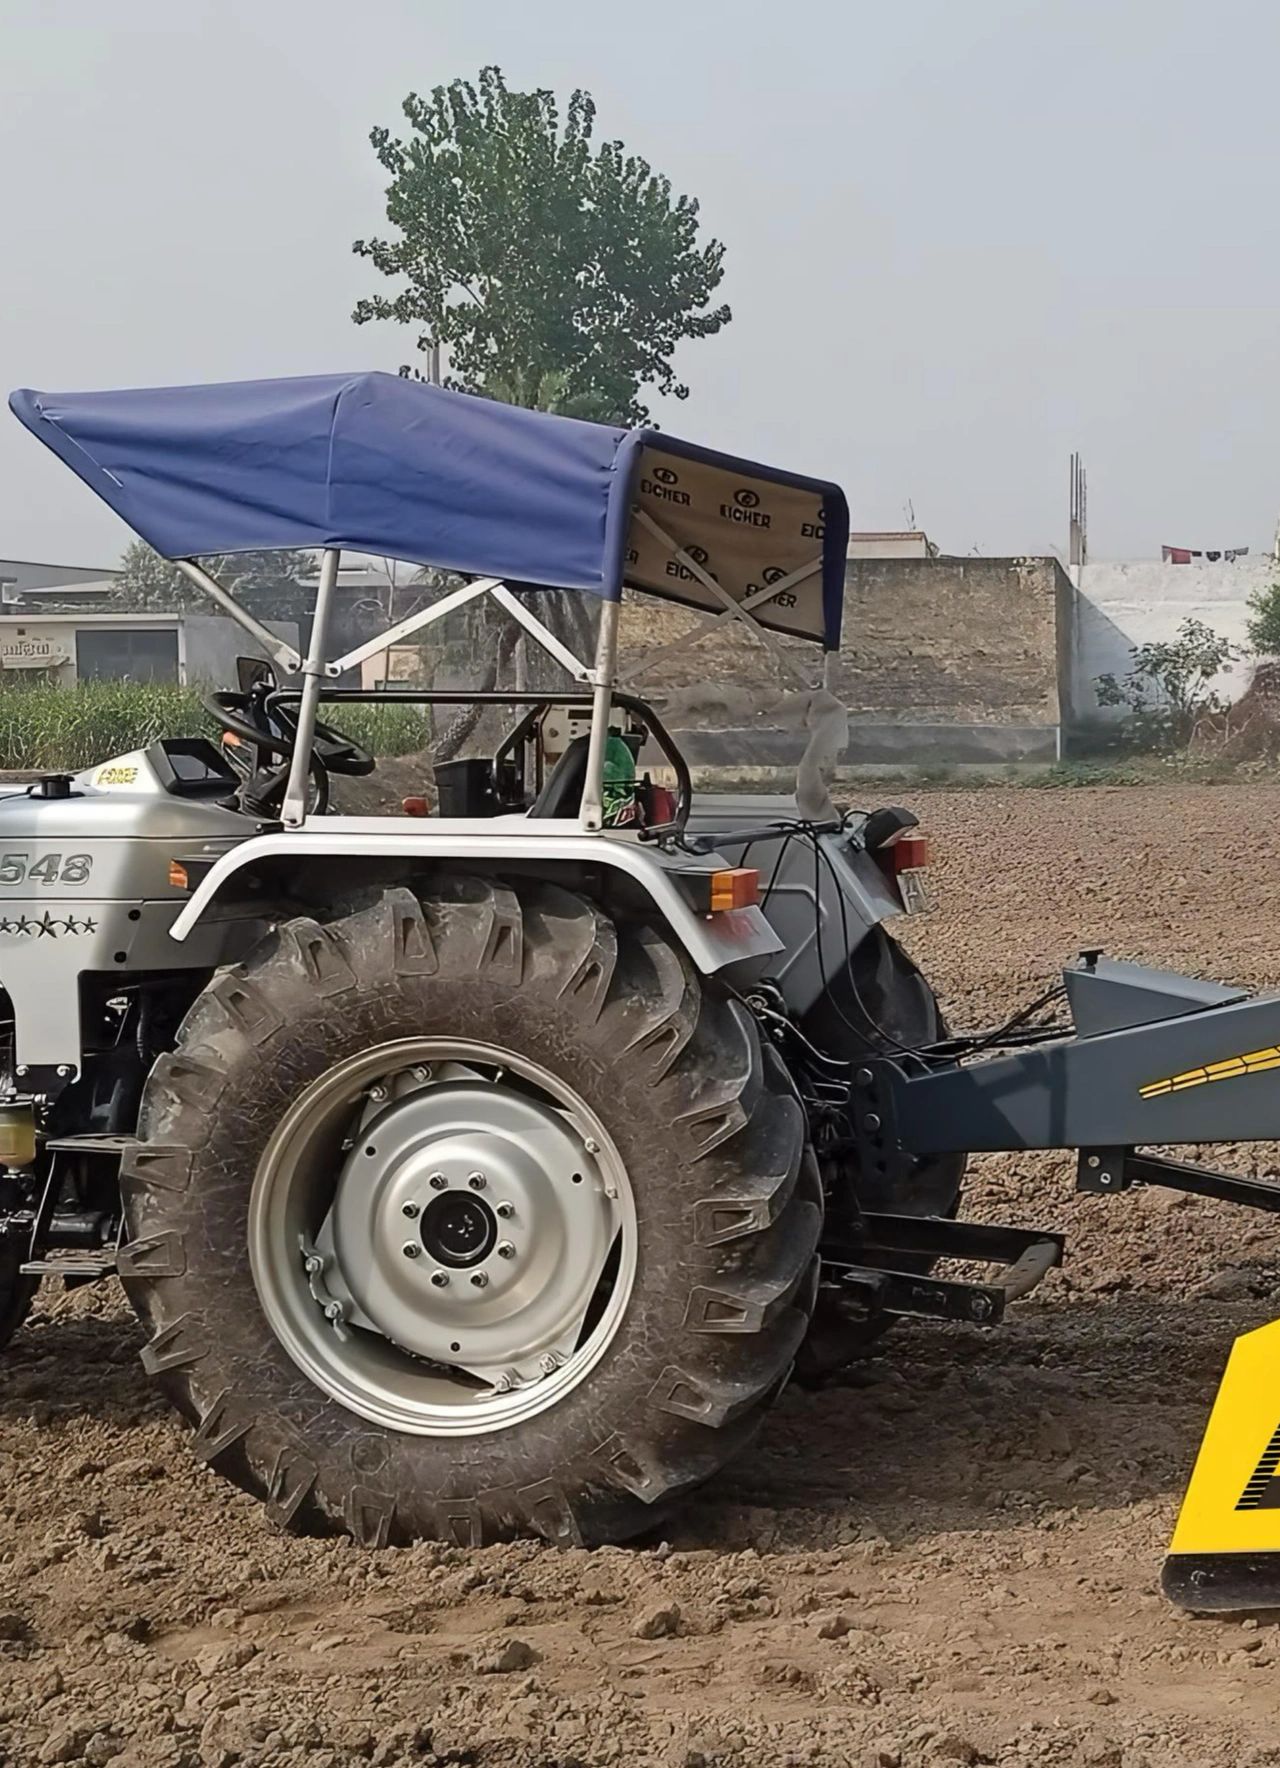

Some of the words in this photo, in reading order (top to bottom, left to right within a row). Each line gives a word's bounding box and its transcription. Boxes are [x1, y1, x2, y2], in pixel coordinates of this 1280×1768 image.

[641, 479, 691, 506] EICHER
[720, 504, 771, 528] EICHER
[801, 523, 824, 539] EIC
[0, 853, 94, 886] 548
